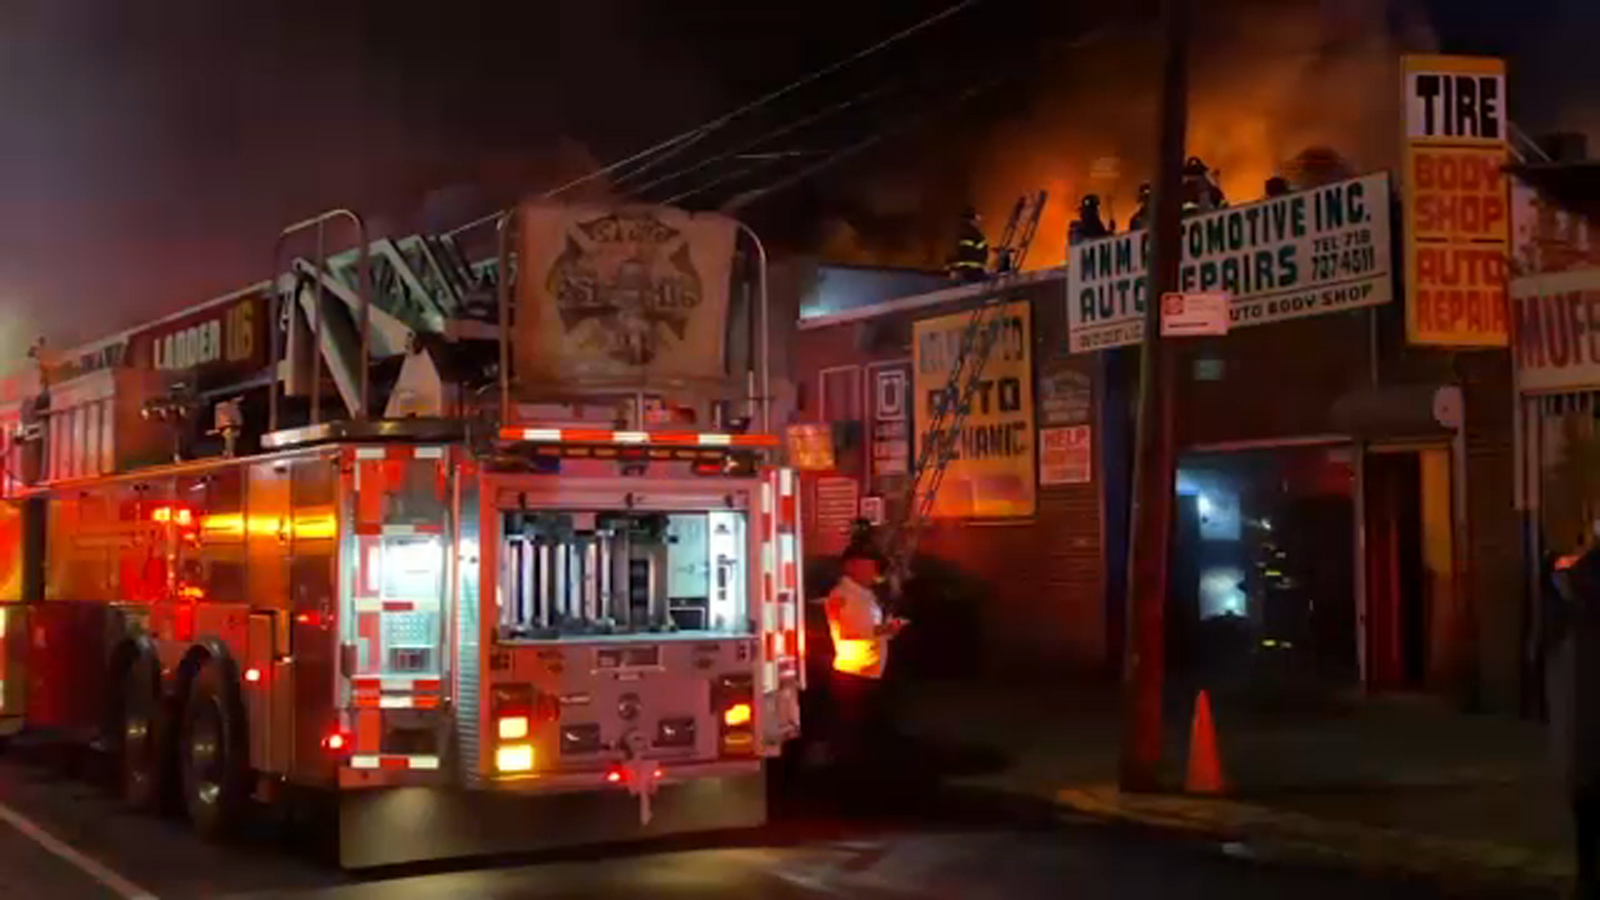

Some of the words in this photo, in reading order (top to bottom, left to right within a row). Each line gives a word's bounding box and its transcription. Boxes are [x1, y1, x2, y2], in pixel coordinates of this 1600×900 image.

[1416, 74, 1499, 138] TIRE
[1415, 154, 1501, 190] BODY
[1314, 182, 1371, 233] INC.
[1415, 196, 1503, 232] SHOP
[1313, 236, 1339, 253] TEL
[1345, 228, 1371, 247] 718
[1181, 244, 1298, 295] EPAIRS
[1419, 250, 1507, 286] AUTO
[1229, 303, 1263, 322] UTO
[1268, 295, 1316, 314] BODY
[1321, 283, 1373, 306] SHOP
[154, 319, 221, 370] LADDER
